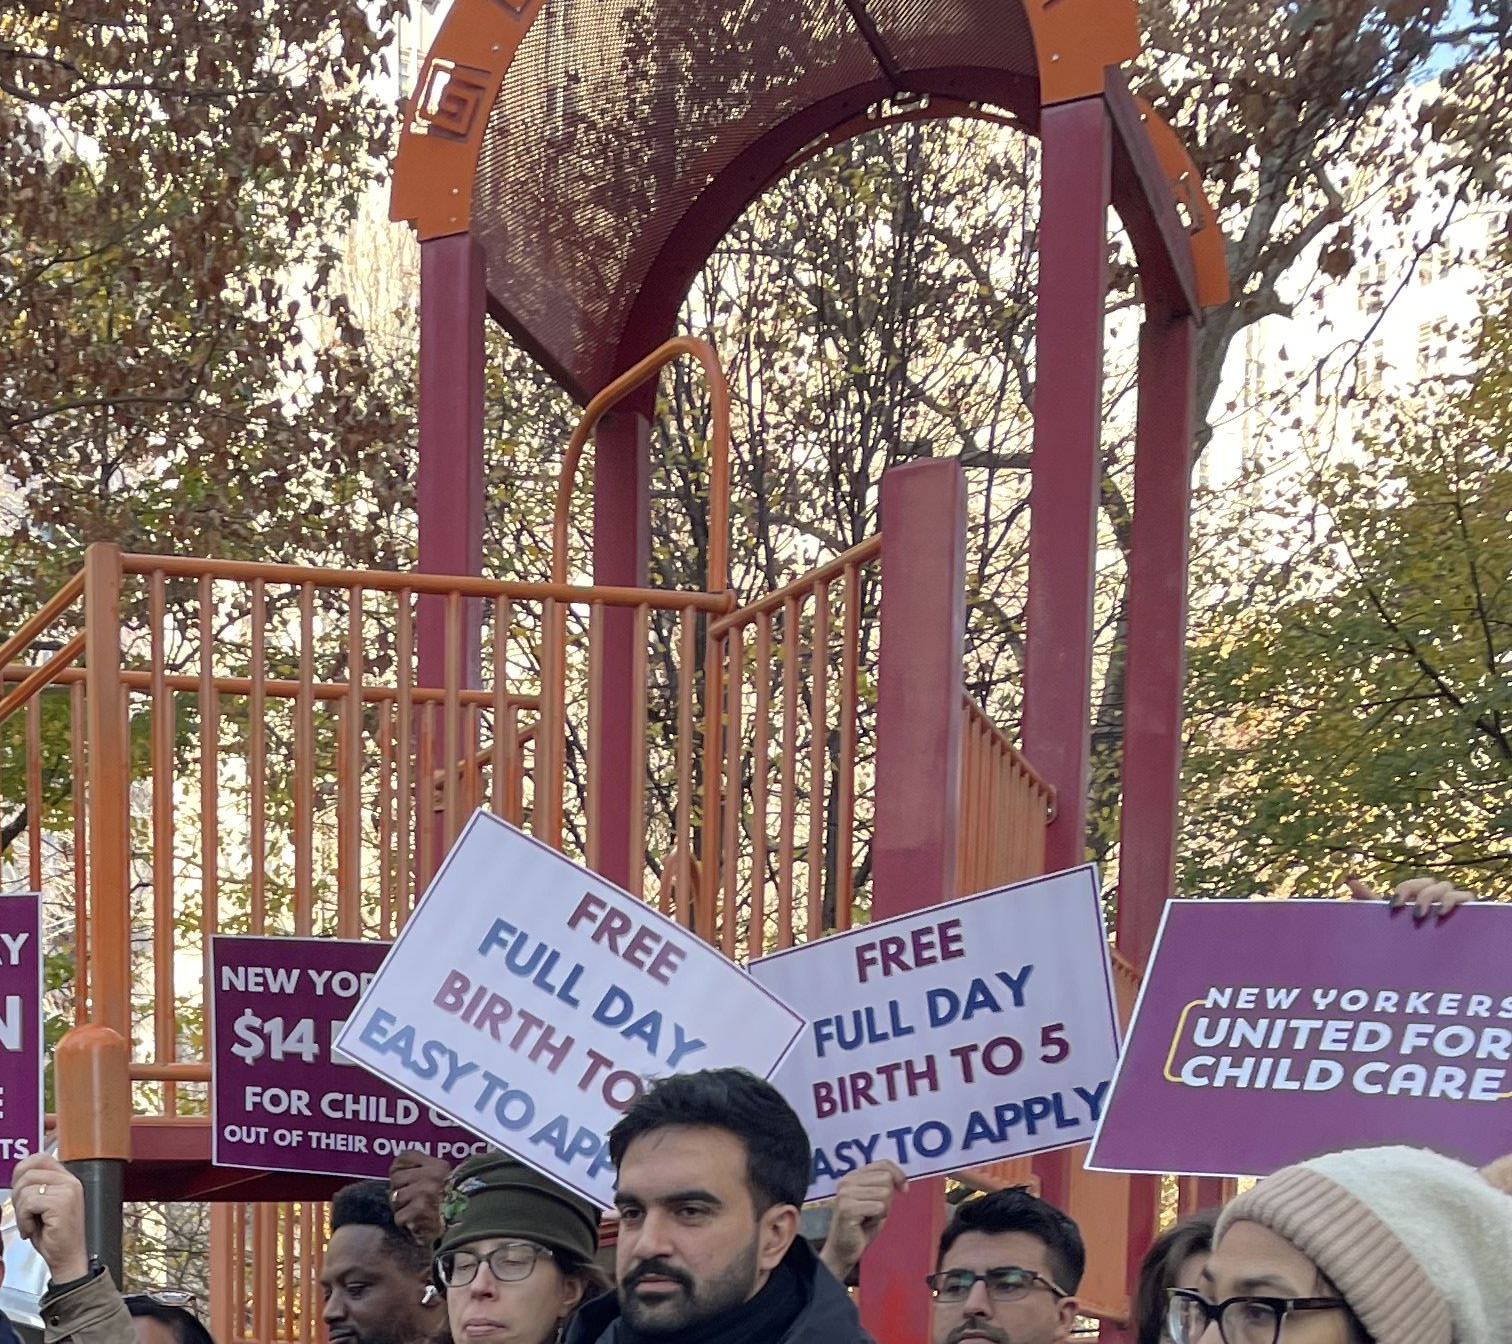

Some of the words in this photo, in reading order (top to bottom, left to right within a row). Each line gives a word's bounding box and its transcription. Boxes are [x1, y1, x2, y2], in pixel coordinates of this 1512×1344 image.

[566, 891, 687, 985] FREE
[855, 919, 965, 983] FREE
[221, 965, 301, 994] NEW
[478, 918, 585, 1008] FULL
[592, 984, 707, 1069] DAY
[813, 1000, 914, 1057] FULL
[926, 965, 1034, 1027] DAY
[1204, 987, 1302, 1009] NEW
[230, 1008, 319, 1066] $14
[433, 970, 576, 1073] BIRTH
[577, 1048, 643, 1111] TO
[1193, 1017, 1392, 1053] UNITED
[1399, 1023, 1512, 1061] FOR
[359, 1008, 480, 1093] EASY
[481, 1070, 535, 1130] TO
[531, 1115, 619, 1191] APP
[813, 1055, 939, 1119] BIRTH
[950, 1036, 1022, 1083] TO
[1040, 1023, 1070, 1064] 5
[1181, 1055, 1344, 1092] CHILD
[1352, 1061, 1506, 1101] CARE
[245, 1086, 312, 1117] FOR
[320, 1092, 419, 1126] CHILD
[808, 1133, 880, 1185] ASY
[886, 1121, 952, 1165] TO
[961, 1080, 1111, 1150] APPLY
[223, 1125, 268, 1145] OUT
[273, 1129, 303, 1146] OF
[308, 1131, 369, 1153] THEIR
